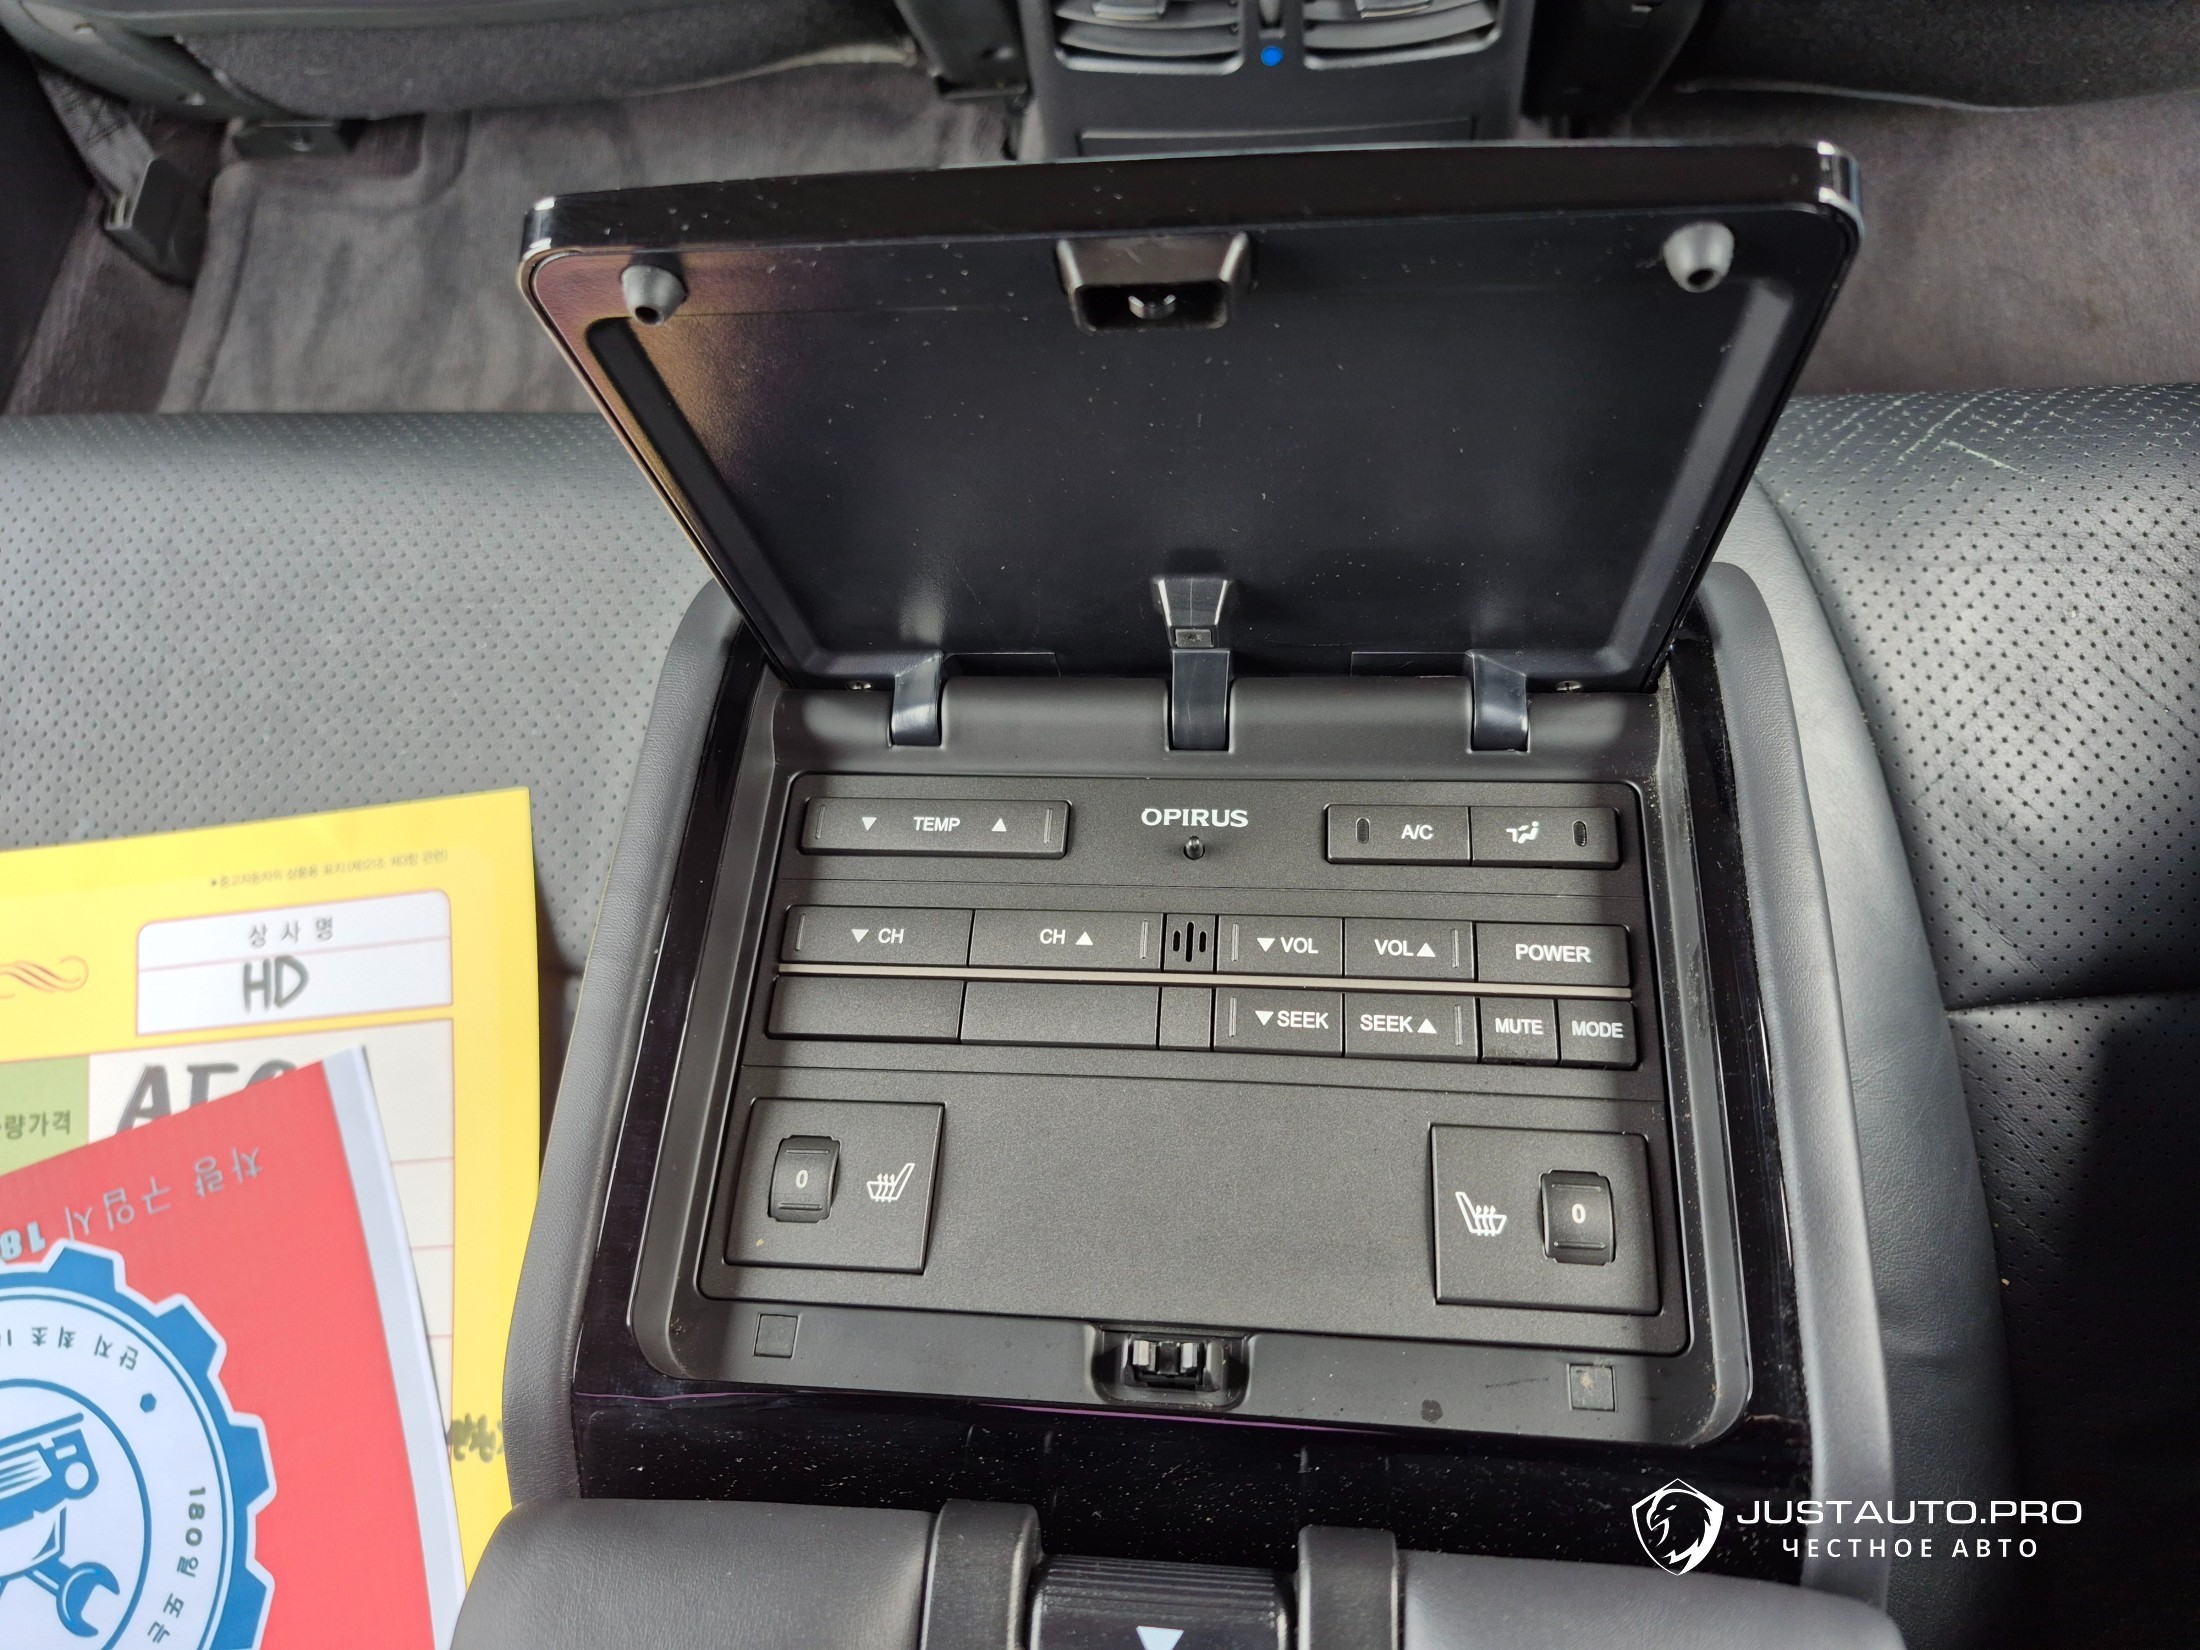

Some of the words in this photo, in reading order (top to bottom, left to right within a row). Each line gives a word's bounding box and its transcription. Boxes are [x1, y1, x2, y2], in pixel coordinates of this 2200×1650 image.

[913, 816, 961, 833] TEMP
[1140, 808, 1249, 828] OPIRUS
[1400, 824, 1434, 841] A/C
[877, 927, 905, 945] CH
[1039, 928, 1067, 946] CH
[1280, 937, 1319, 955] VOL
[1374, 938, 1415, 958] VOL
[1515, 943, 1592, 963] POWER
[242, 955, 310, 1014] HD
[1276, 1011, 1329, 1031] SEEK
[1360, 1013, 1413, 1033] SEEK
[1495, 1017, 1544, 1036] MUTE
[1571, 1020, 1624, 1039] MODE
[0, 1110, 71, 1141] 량가격
[193, 1147, 263, 1198] 차량
[795, 1169, 809, 1189] 0
[64, 1174, 172, 1241] 구입시
[1571, 1203, 1587, 1224] 0
[31, 1326, 76, 1349] 최초
[177, 1486, 207, 1578] 180일
[147, 1592, 185, 1644] 또는
